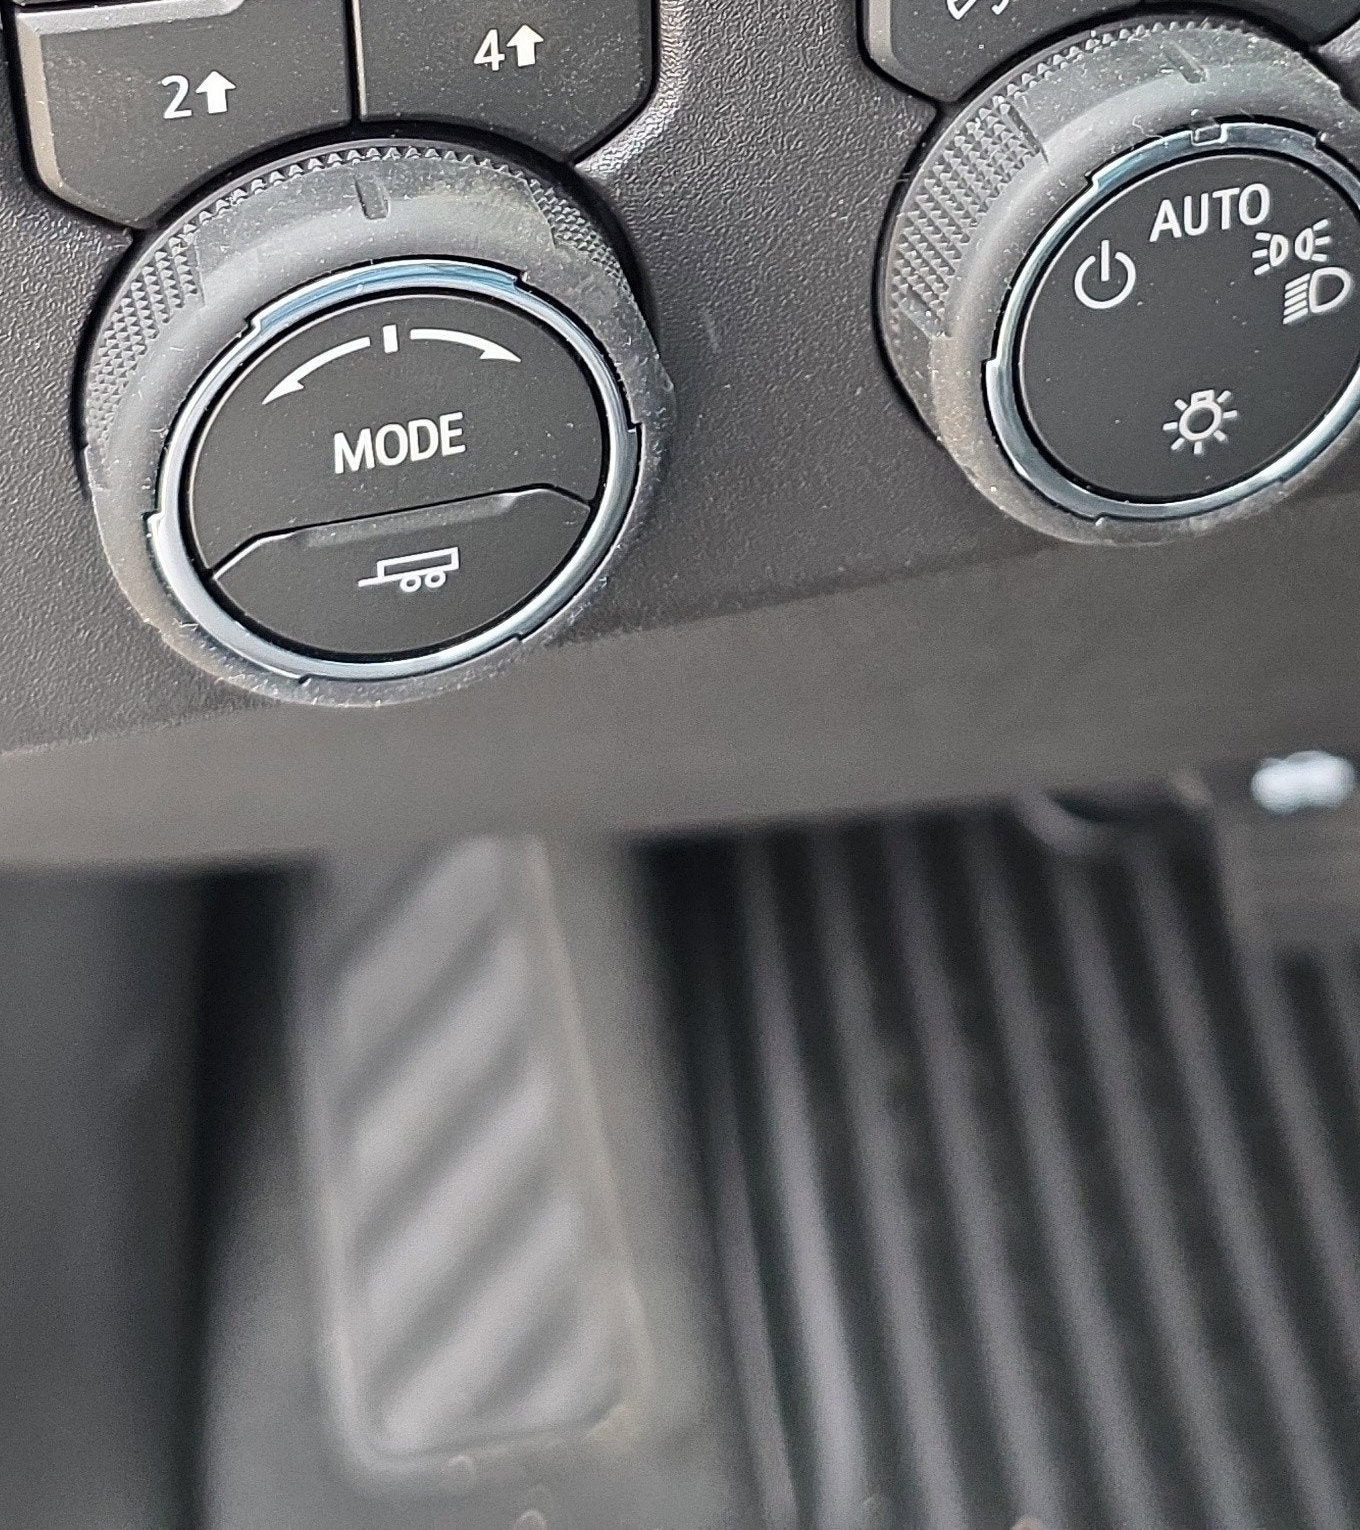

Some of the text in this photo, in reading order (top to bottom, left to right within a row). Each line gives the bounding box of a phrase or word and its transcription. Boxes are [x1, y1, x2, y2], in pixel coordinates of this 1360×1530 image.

[473, 28, 506, 72] 4
[161, 74, 193, 119] 2
[1148, 182, 1271, 243] AUTO
[333, 411, 467, 475] MODE
